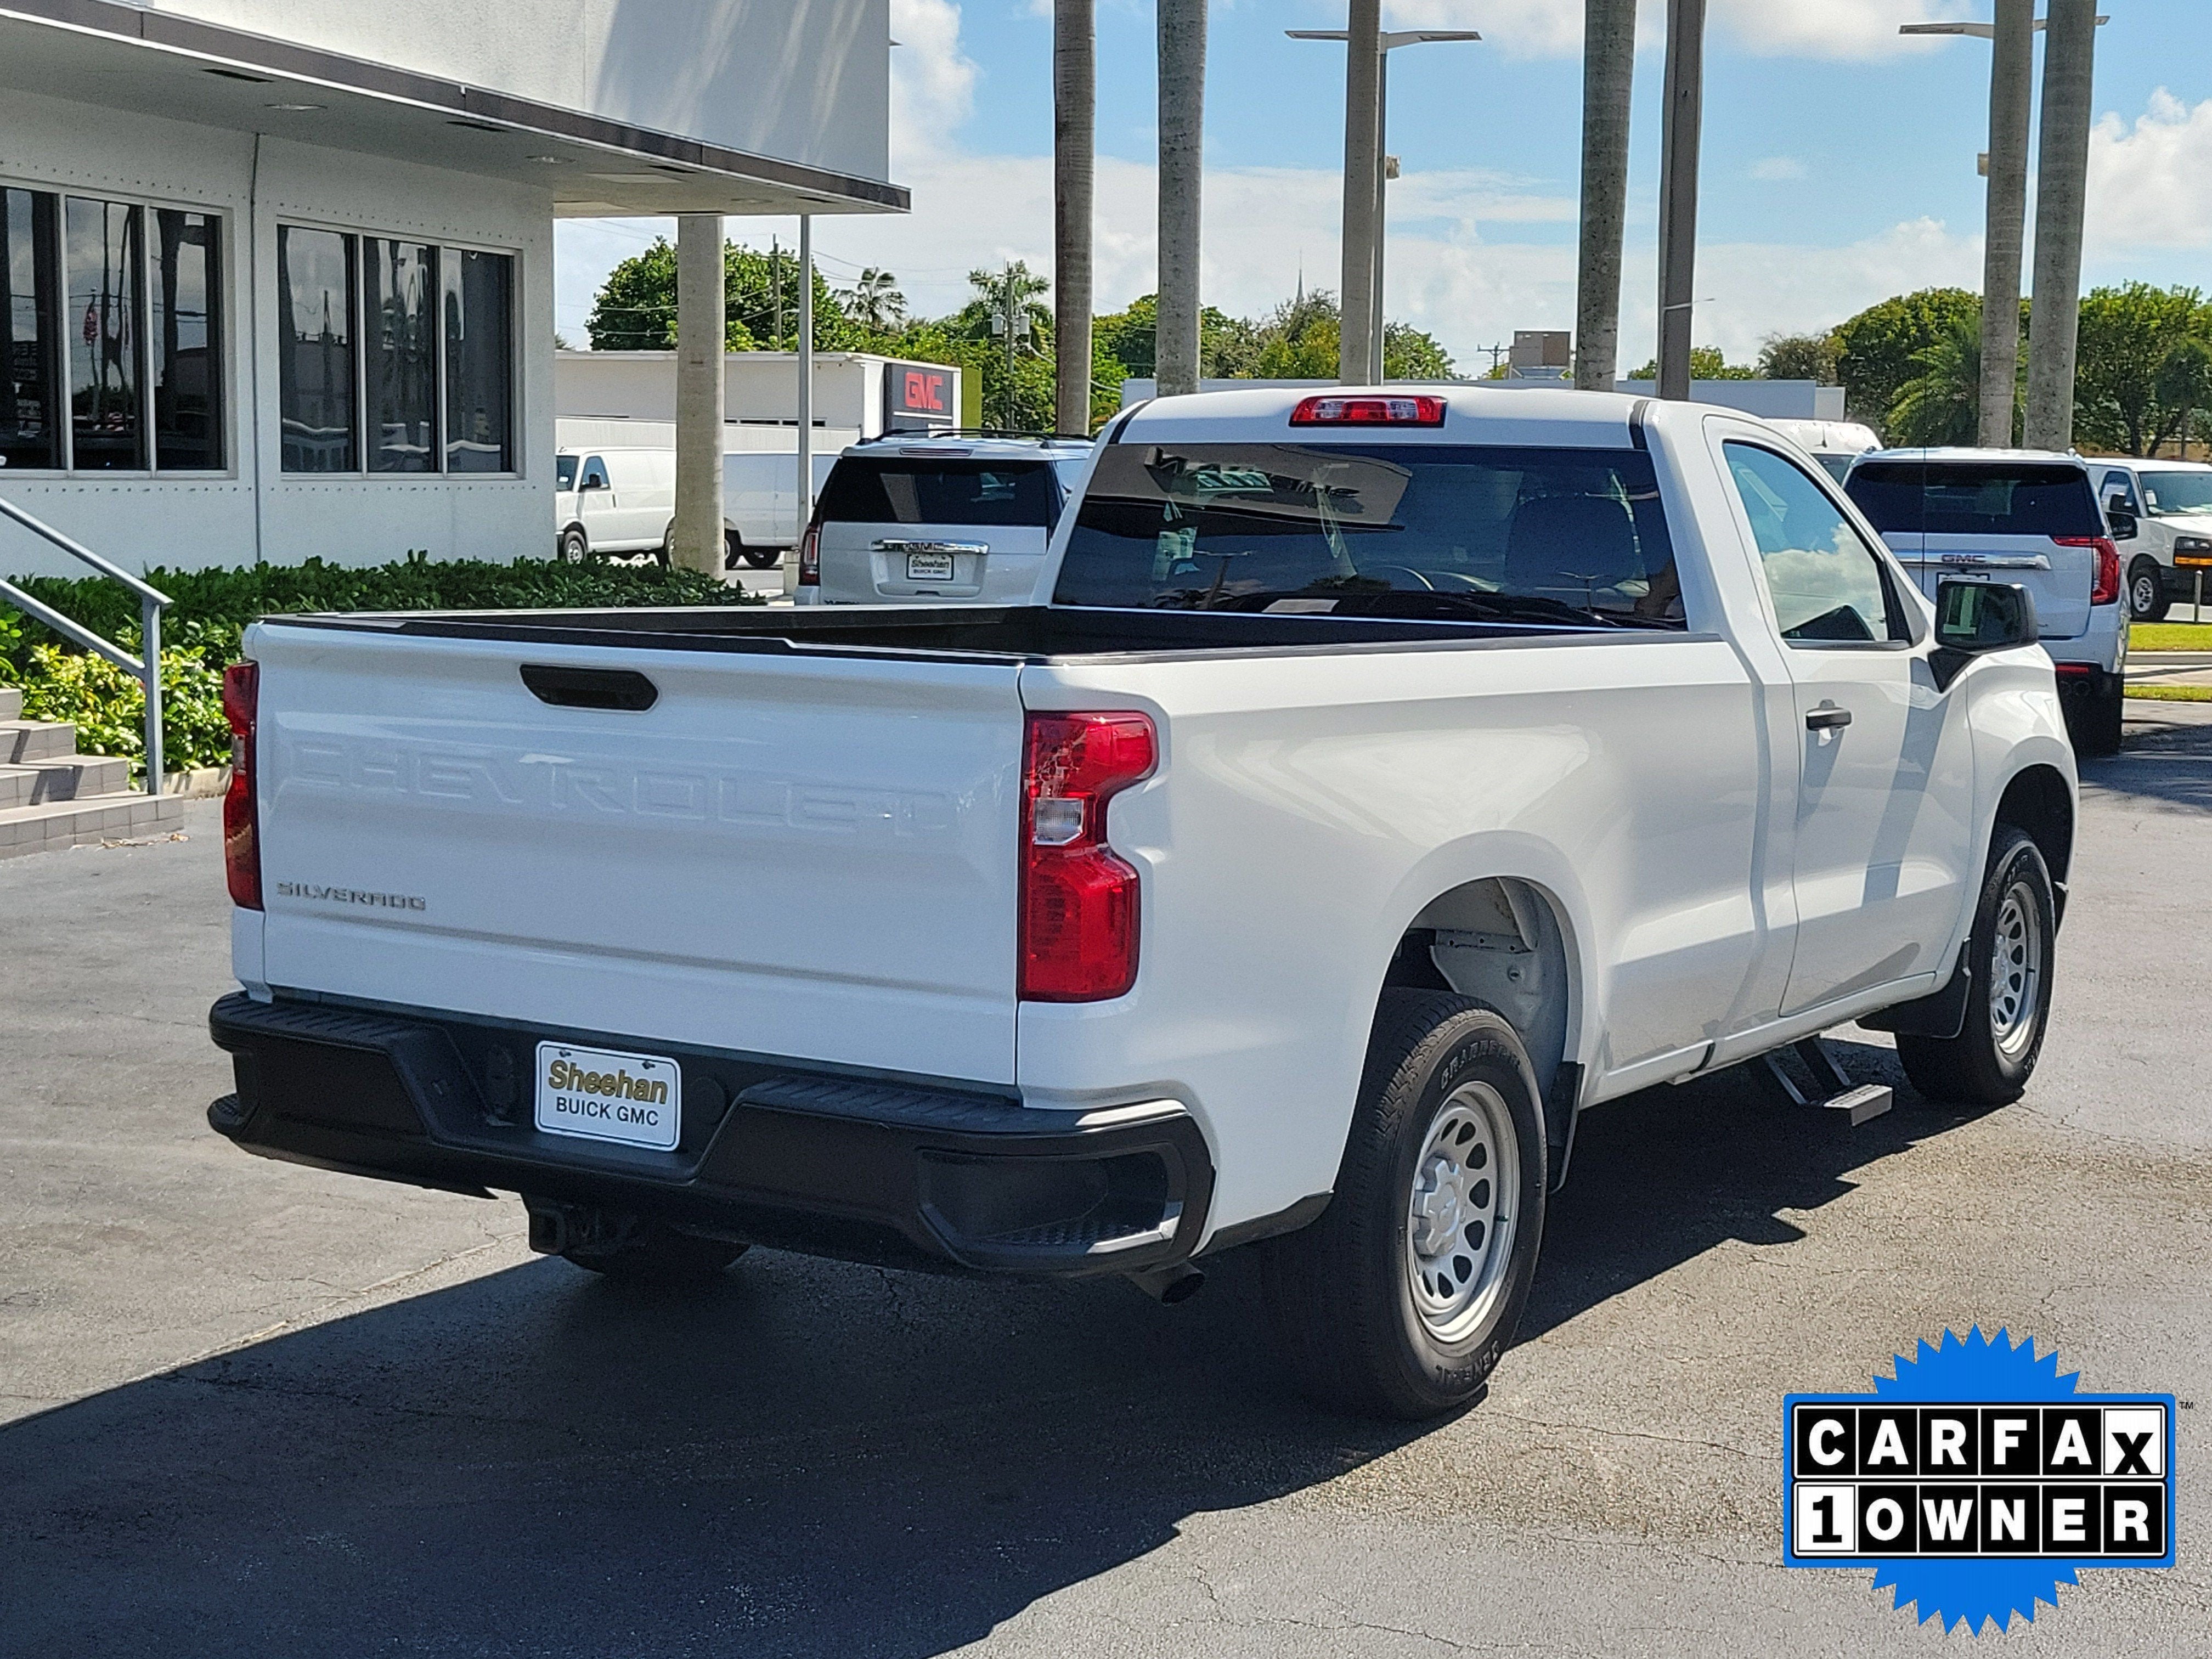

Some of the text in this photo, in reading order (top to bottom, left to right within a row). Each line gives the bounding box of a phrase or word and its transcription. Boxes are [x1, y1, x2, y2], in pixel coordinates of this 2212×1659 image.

[905, 372, 943, 410] GMC
[1942, 554, 1987, 563] GMC
[292, 741, 948, 837] CHEVROLET
[276, 881, 426, 911] SILVERADO
[549, 1059, 669, 1105] Sheehan
[556, 1096, 659, 1126] BUICK GMC
